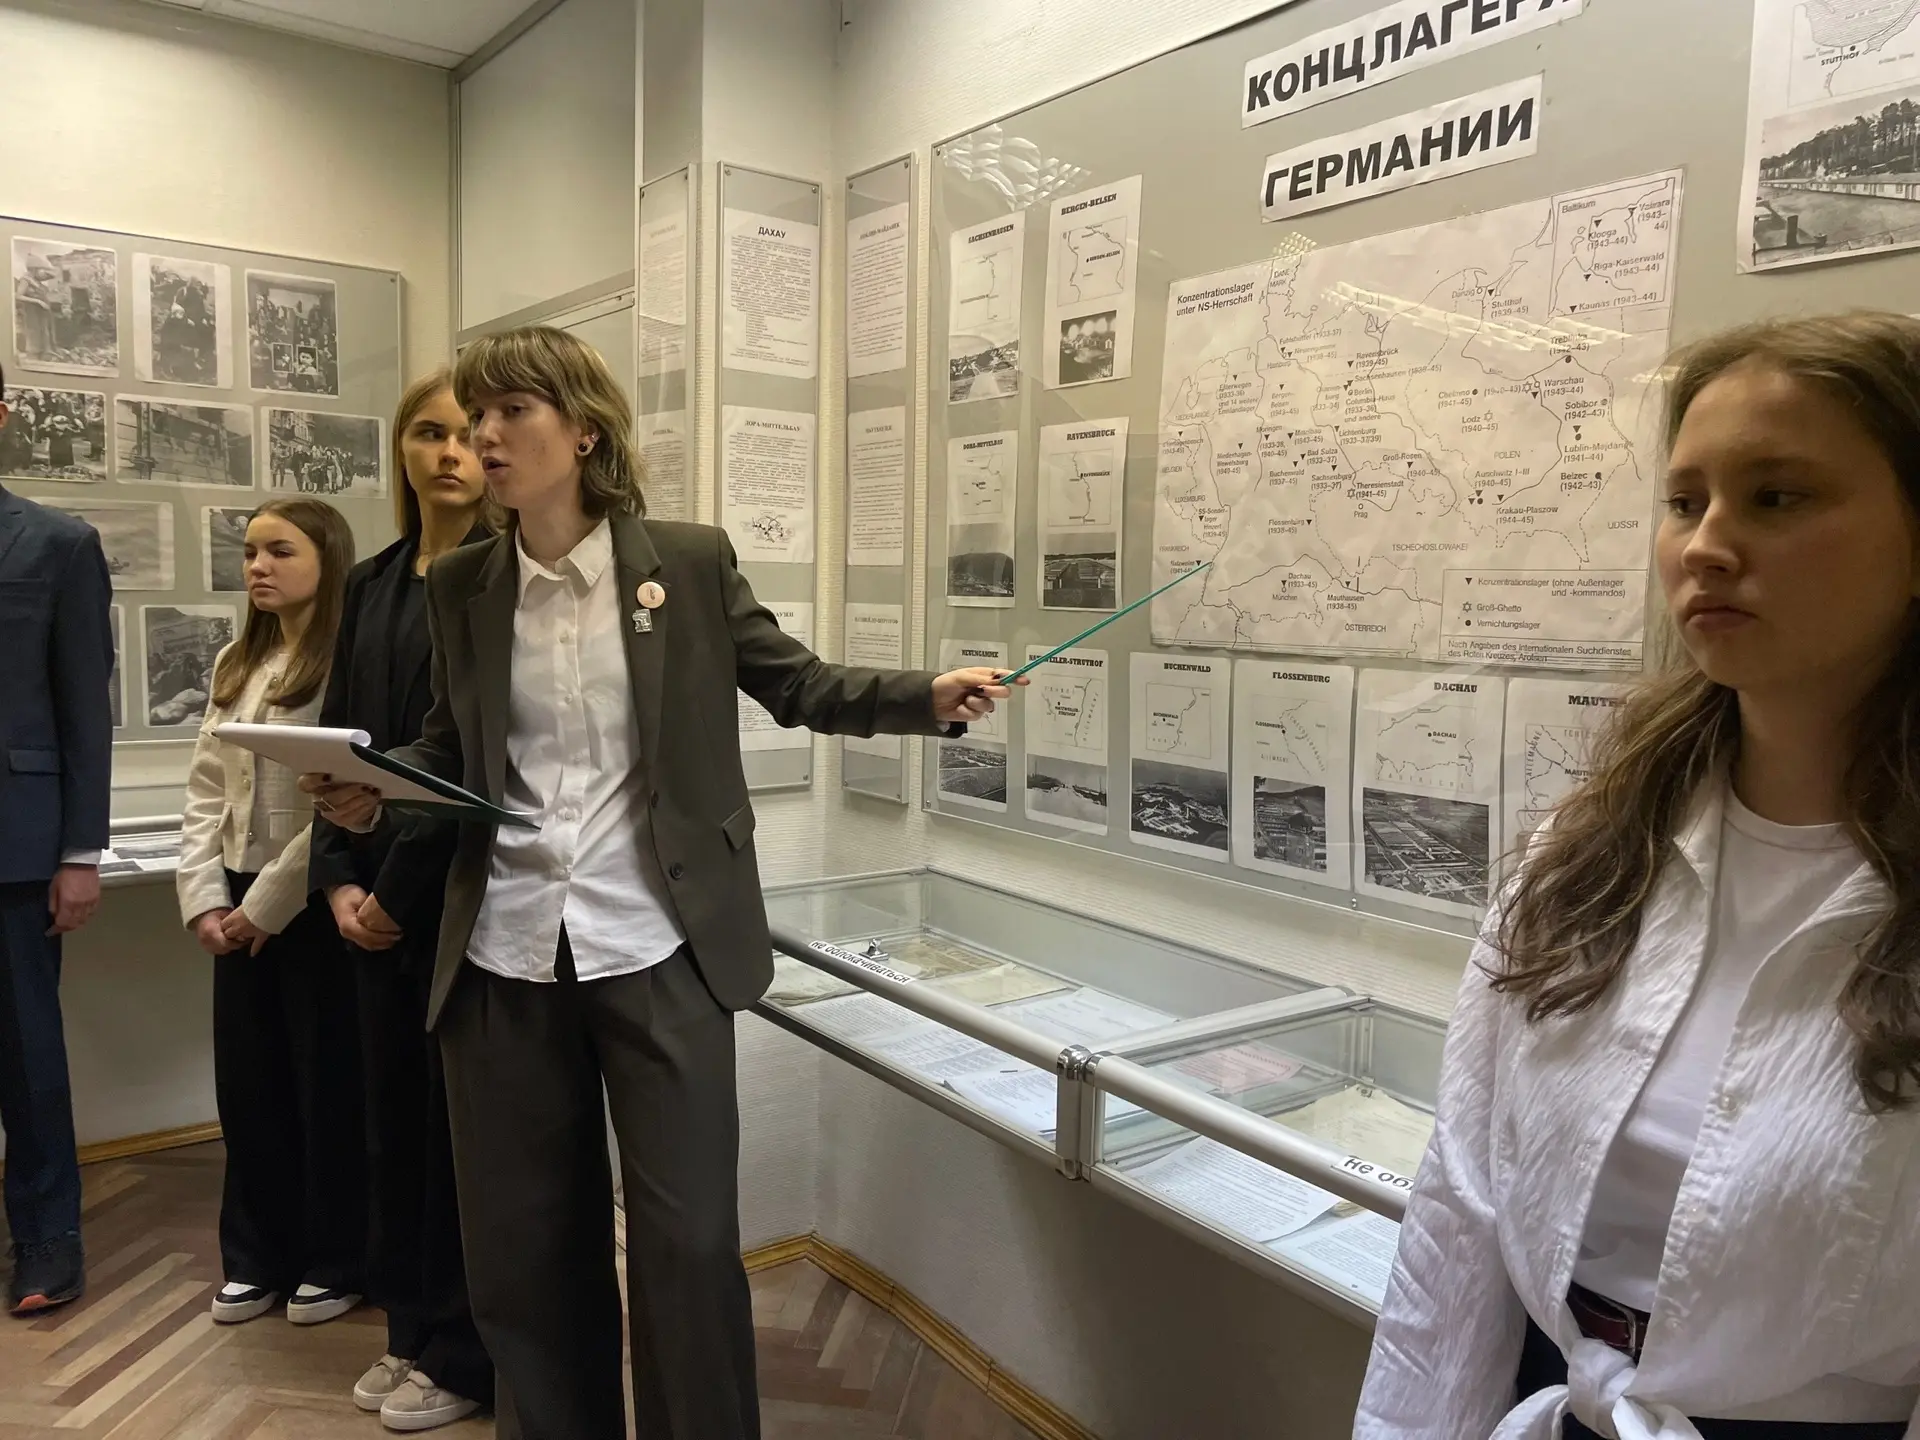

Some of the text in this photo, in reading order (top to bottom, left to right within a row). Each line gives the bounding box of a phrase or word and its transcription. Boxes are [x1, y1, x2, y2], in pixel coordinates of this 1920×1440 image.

[1247, 0, 1569, 112] КОНЦЛАГЕР
[1821, 51, 1860, 66] STUTTHOF
[1265, 97, 1534, 207] ГЕРМАНИИ
[1061, 193, 1117, 216] BERGEN-BELSEN
[1562, 200, 1596, 214] Baltikum
[758, 226, 786, 238] ДАХАУ
[1588, 229, 1616, 240] Klooga
[1594, 252, 1664, 271] Riga-Kaiserwald
[1177, 281, 1254, 304] Konzentrationslager
[1176, 293, 1253, 316] unter NS-Herrschaft
[1544, 376, 1584, 387] Warschau
[1565, 400, 1598, 410] Sobibor
[1462, 416, 1481, 424] Lodz
[1494, 451, 1521, 459] POLEN
[1270, 469, 1304, 478] Buchenwald
[1475, 469, 1514, 478] Auschwitz
[1356, 481, 1404, 490] Theresienstadt
[1354, 511, 1368, 519] Prag
[1497, 506, 1559, 515] Krakau-Plaszow
[1608, 520, 1638, 529] UDSSR
[1478, 577, 1624, 589] Konzentrationslager (ohne Außenlager
[1326, 594, 1364, 602] Mauthausen
[1552, 588, 1626, 598] und -kommandos)
[1476, 603, 1522, 613] Groß-Ghetto
[1345, 623, 1386, 632] ÖSTERREICH
[1477, 620, 1541, 630] Vernichtungslager
[1448, 640, 1468, 648] Nach
[1470, 641, 1500, 652] Angaben
[1502, 642, 1516, 650] des
[1518, 642, 1574, 654] Internationalen
[1164, 662, 1211, 672] BUCHENWALD
[1273, 672, 1330, 683] FLOSSENBURG
[1434, 682, 1478, 692] DACHAU
